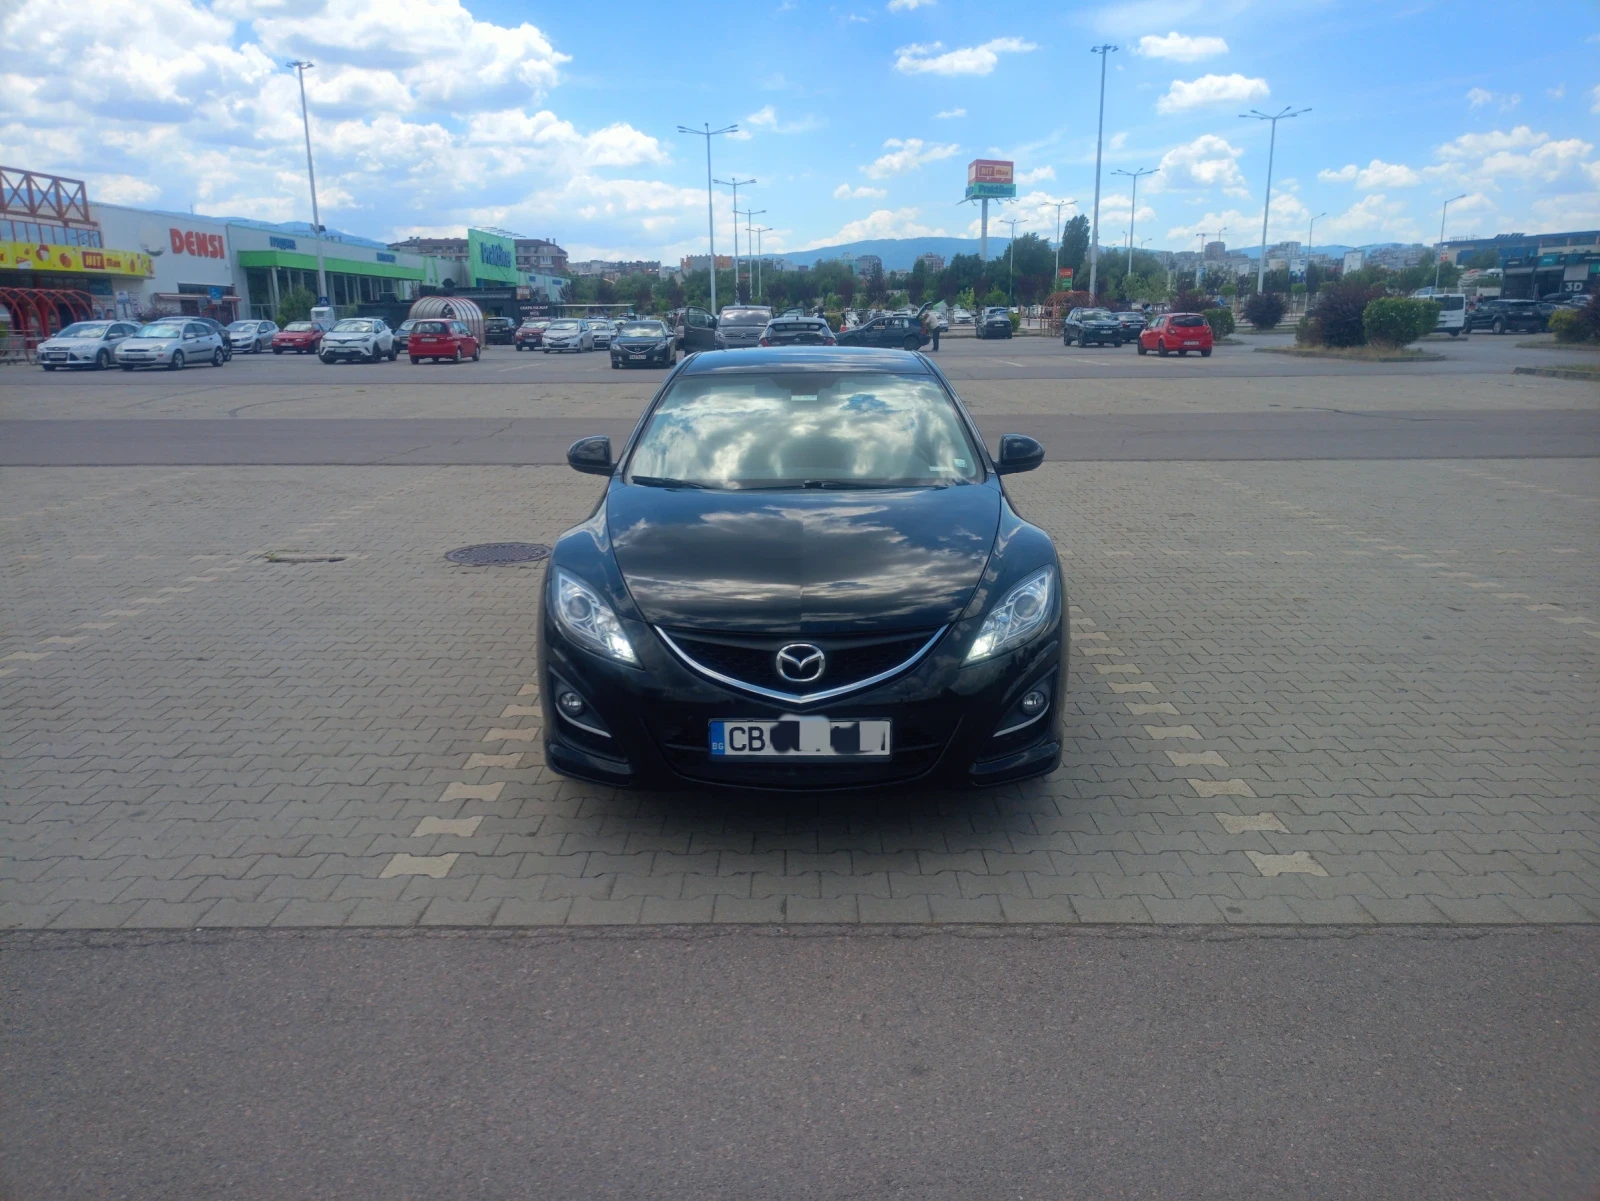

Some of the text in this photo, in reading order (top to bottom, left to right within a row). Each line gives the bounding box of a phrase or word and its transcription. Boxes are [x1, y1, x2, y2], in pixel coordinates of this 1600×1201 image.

[169, 228, 225, 259] DENSI
[85, 254, 102, 267] HIT
[1565, 282, 1583, 292] 3D
[729, 726, 766, 752] CB
[712, 742, 724, 750] BG
